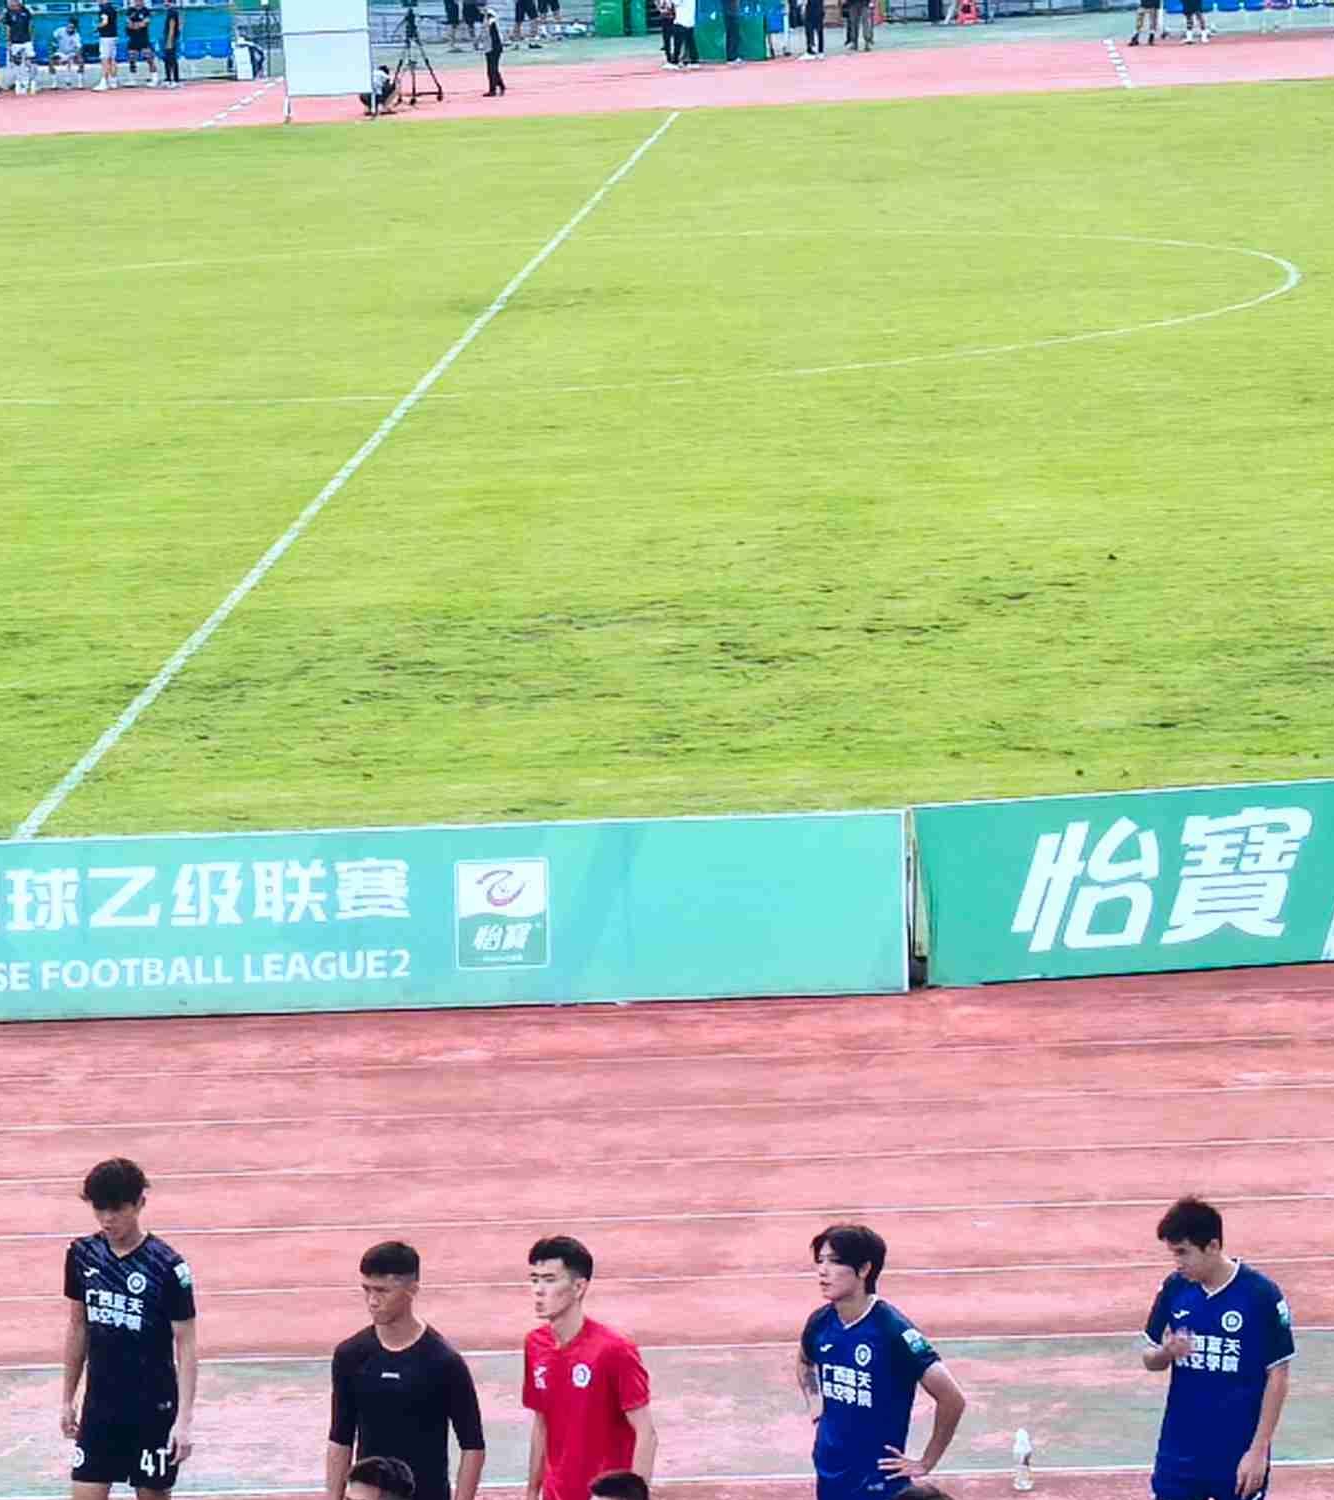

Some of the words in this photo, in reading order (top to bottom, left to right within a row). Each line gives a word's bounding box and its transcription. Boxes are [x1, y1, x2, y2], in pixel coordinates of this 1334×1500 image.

[1010, 805, 1313, 952] 怡寶
[40, 951, 235, 990] FOOTBALL
[243, 948, 413, 984] LEAGUE2
